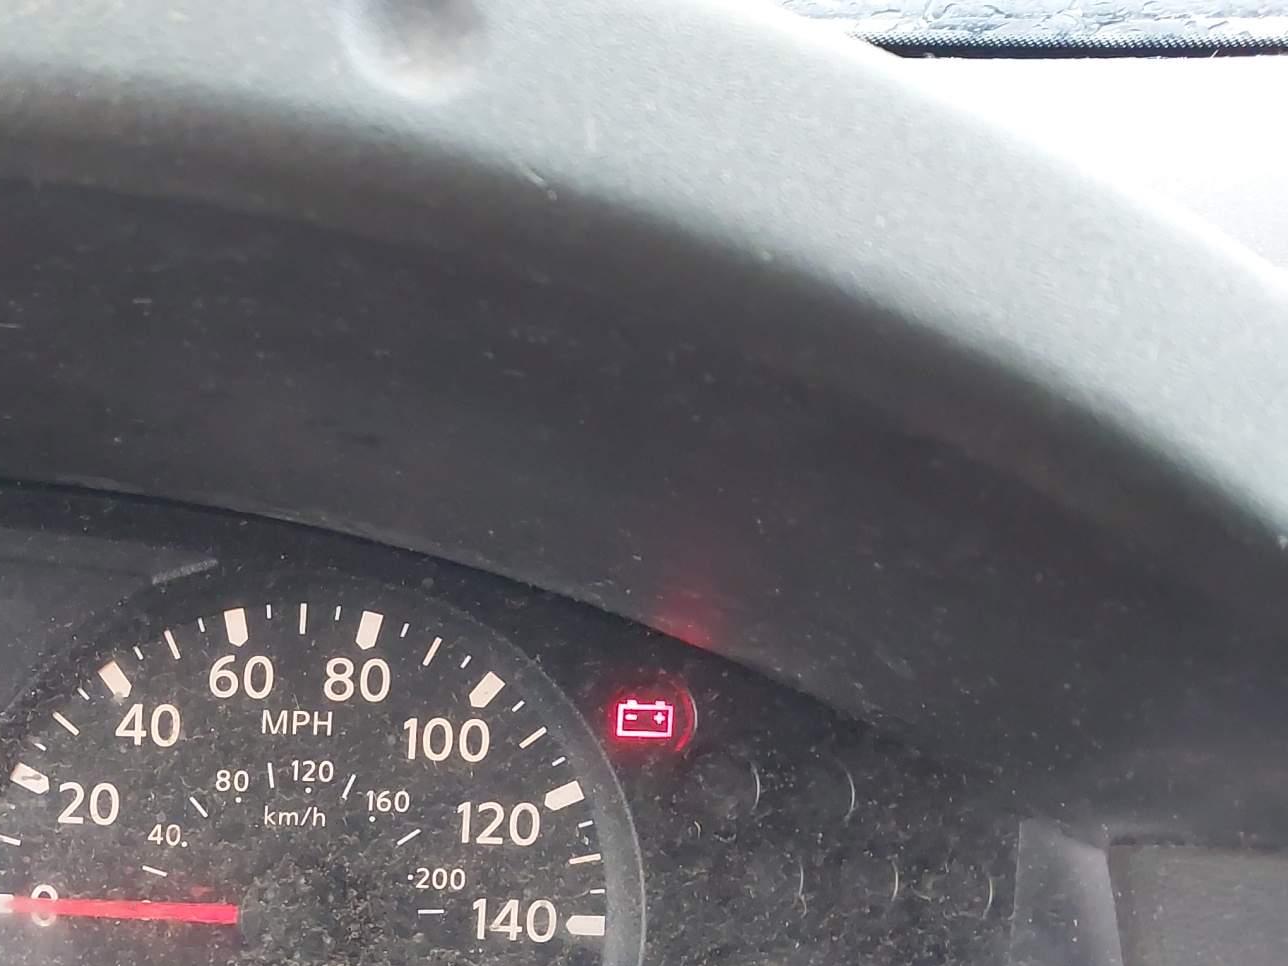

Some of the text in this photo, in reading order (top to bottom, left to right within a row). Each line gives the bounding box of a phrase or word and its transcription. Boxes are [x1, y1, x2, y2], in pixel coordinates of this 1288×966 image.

[210, 655, 275, 700] 60
[323, 657, 391, 702] 80
[114, 703, 181, 747] 40
[260, 709, 333, 737] MPH
[403, 718, 490, 762] 100
[215, 769, 250, 793] 80
[291, 760, 334, 784] 120
[57, 782, 120, 826] 20
[263, 805, 327, 829] km/h
[366, 790, 410, 814] 160
[147, 823, 181, 847] 40
[457, 802, 540, 846] 120
[415, 868, 466, 891] 200
[30, 884, 59, 927] 0
[471, 899, 557, 943] 140
